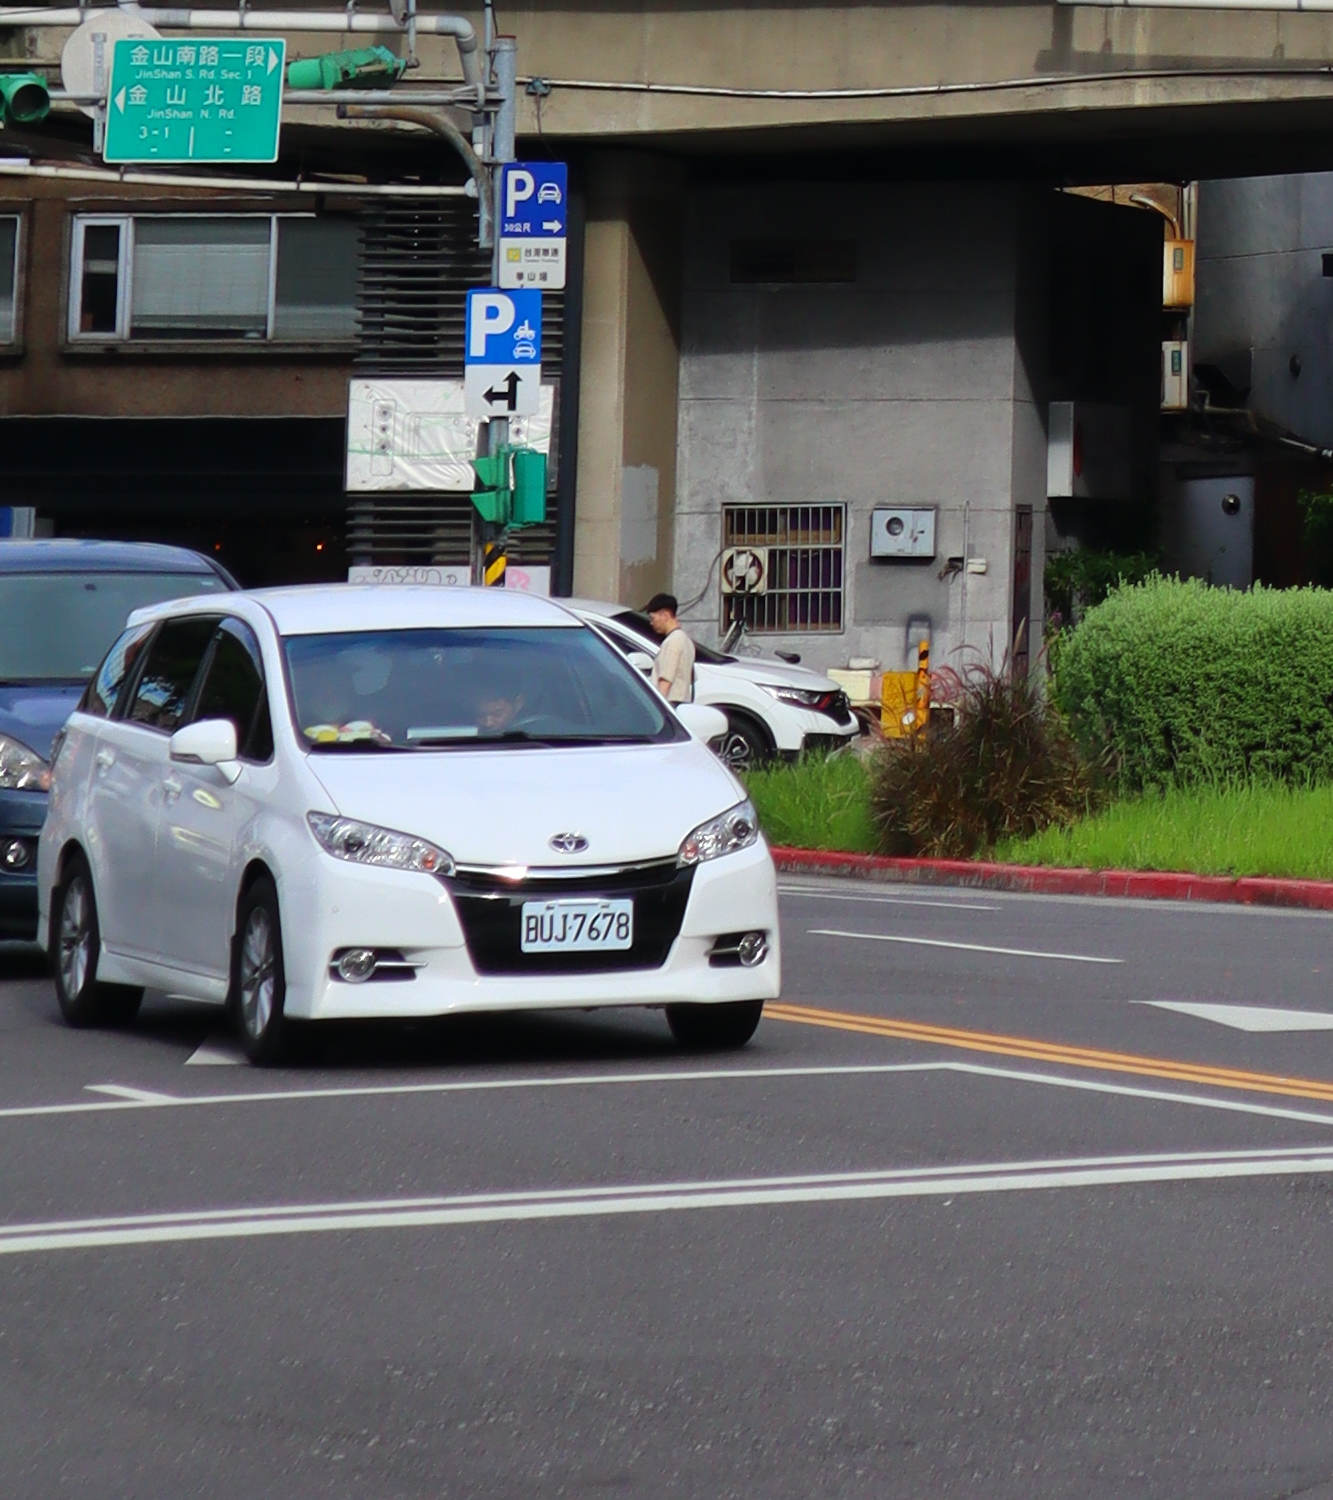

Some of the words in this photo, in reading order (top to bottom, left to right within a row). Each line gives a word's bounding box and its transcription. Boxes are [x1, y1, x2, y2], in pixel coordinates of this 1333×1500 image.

[129, 45, 266, 68] 金山南路一段
[128, 83, 263, 106] 金山北路
[147, 108, 194, 120] JinShan
[506, 170, 535, 217] P
[470, 293, 515, 356] P
[525, 912, 630, 944] BUJ-7678
